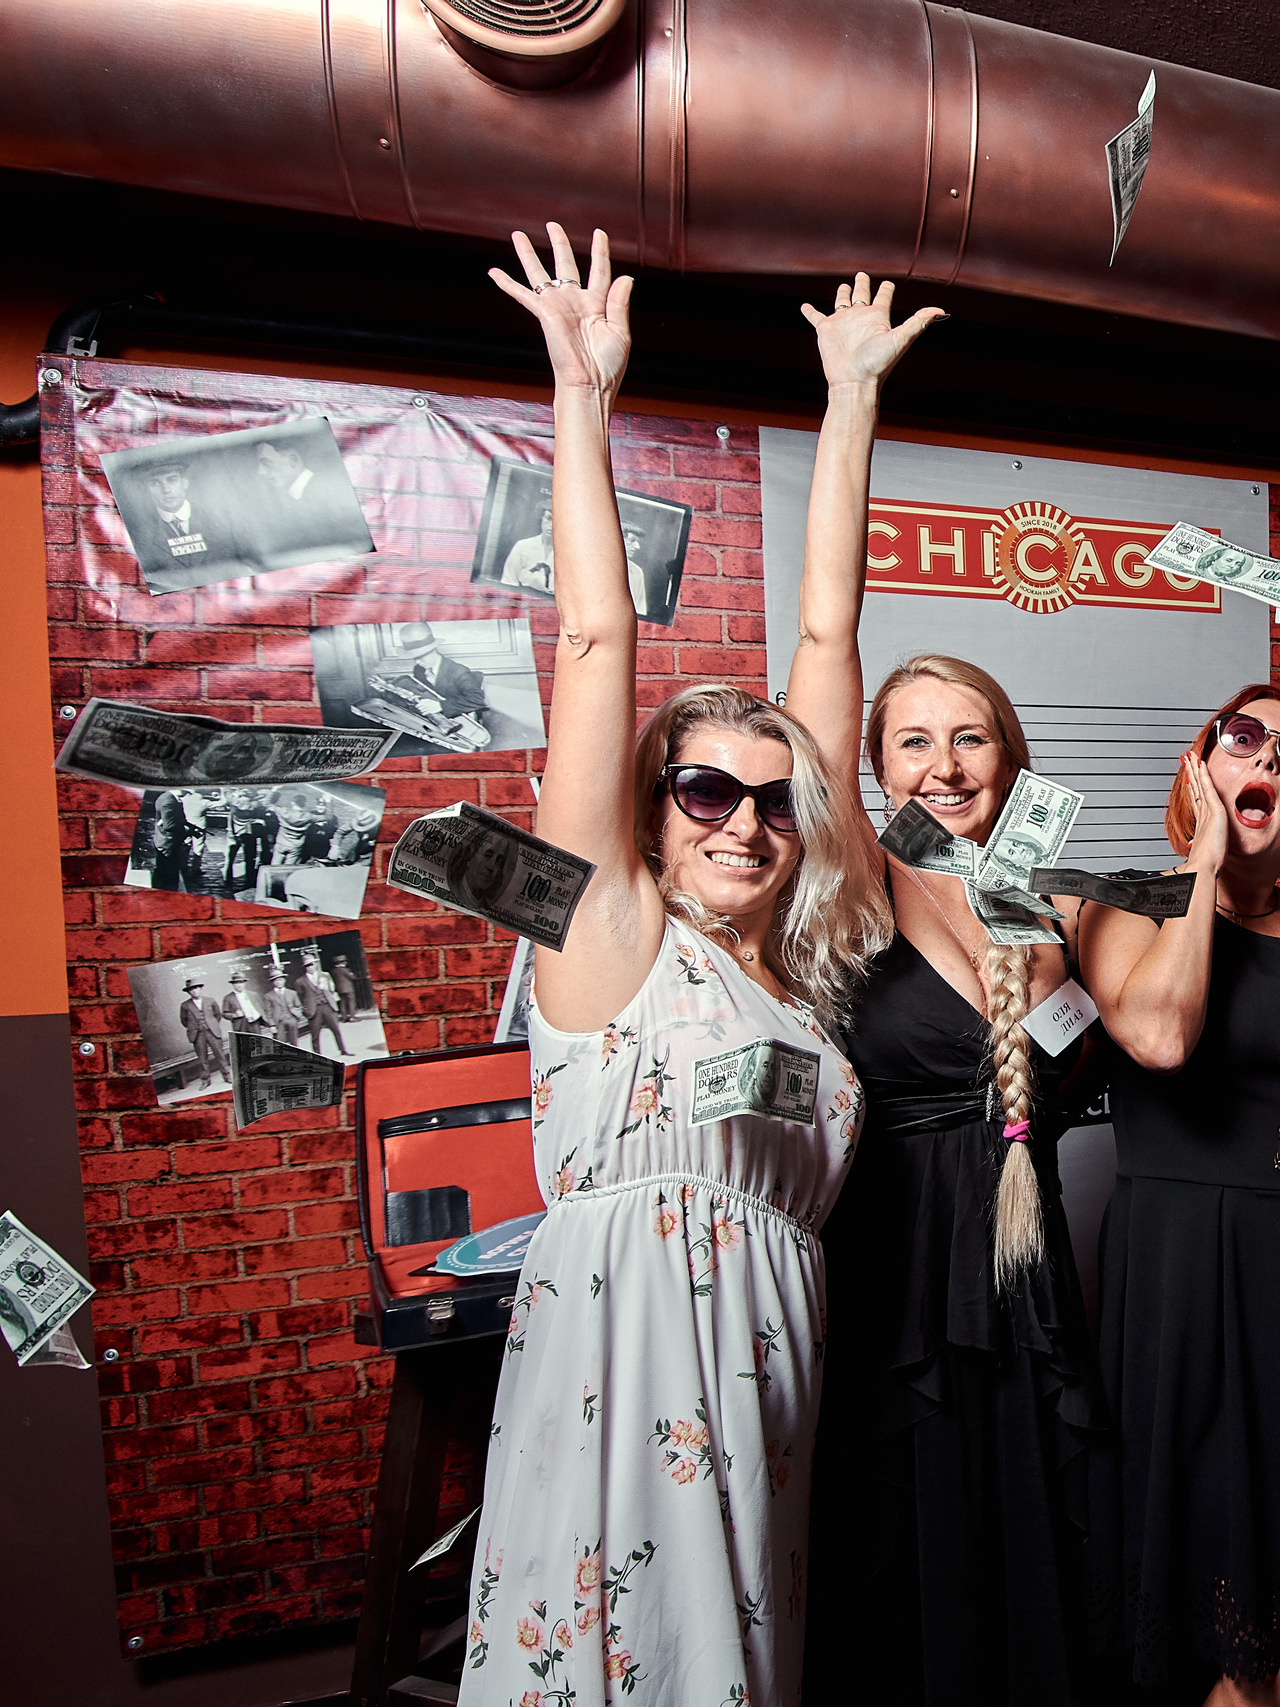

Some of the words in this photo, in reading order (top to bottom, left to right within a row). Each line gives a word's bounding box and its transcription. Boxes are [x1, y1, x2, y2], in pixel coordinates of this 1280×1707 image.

[1021, 519, 1041, 528] SINCE
[1042, 520, 1058, 531] 2018
[866, 519, 1202, 592] CHICAG
[1019, 585, 1042, 596] HOOKAH
[1043, 587, 1060, 596] FAMILY
[1038, 788, 1047, 801] PLAY
[1044, 789, 1056, 807] MONEY
[1026, 804, 1049, 829] 100
[1056, 797, 1070, 819] 100
[935, 844, 954, 857] 100
[405, 862, 417, 873] GOD
[417, 868, 427, 876] WE
[427, 871, 445, 883] TRUST
[520, 871, 552, 902] 100
[554, 886, 571, 899] PLAY
[546, 895, 569, 911] MONEY
[532, 914, 560, 932] 100
[1052, 1001, 1071, 1022] ОЛЯ
[1060, 1009, 1084, 1035] ДИАЗ
[698, 1068, 711, 1080] ONE
[711, 1059, 739, 1077] HUNDRED
[786, 1072, 802, 1094] 100
[696, 1092, 711, 1103] PLAY
[713, 1085, 736, 1097] MONEY
[723, 1096, 739, 1104] TRUST
[795, 1103, 811, 1114] 100
